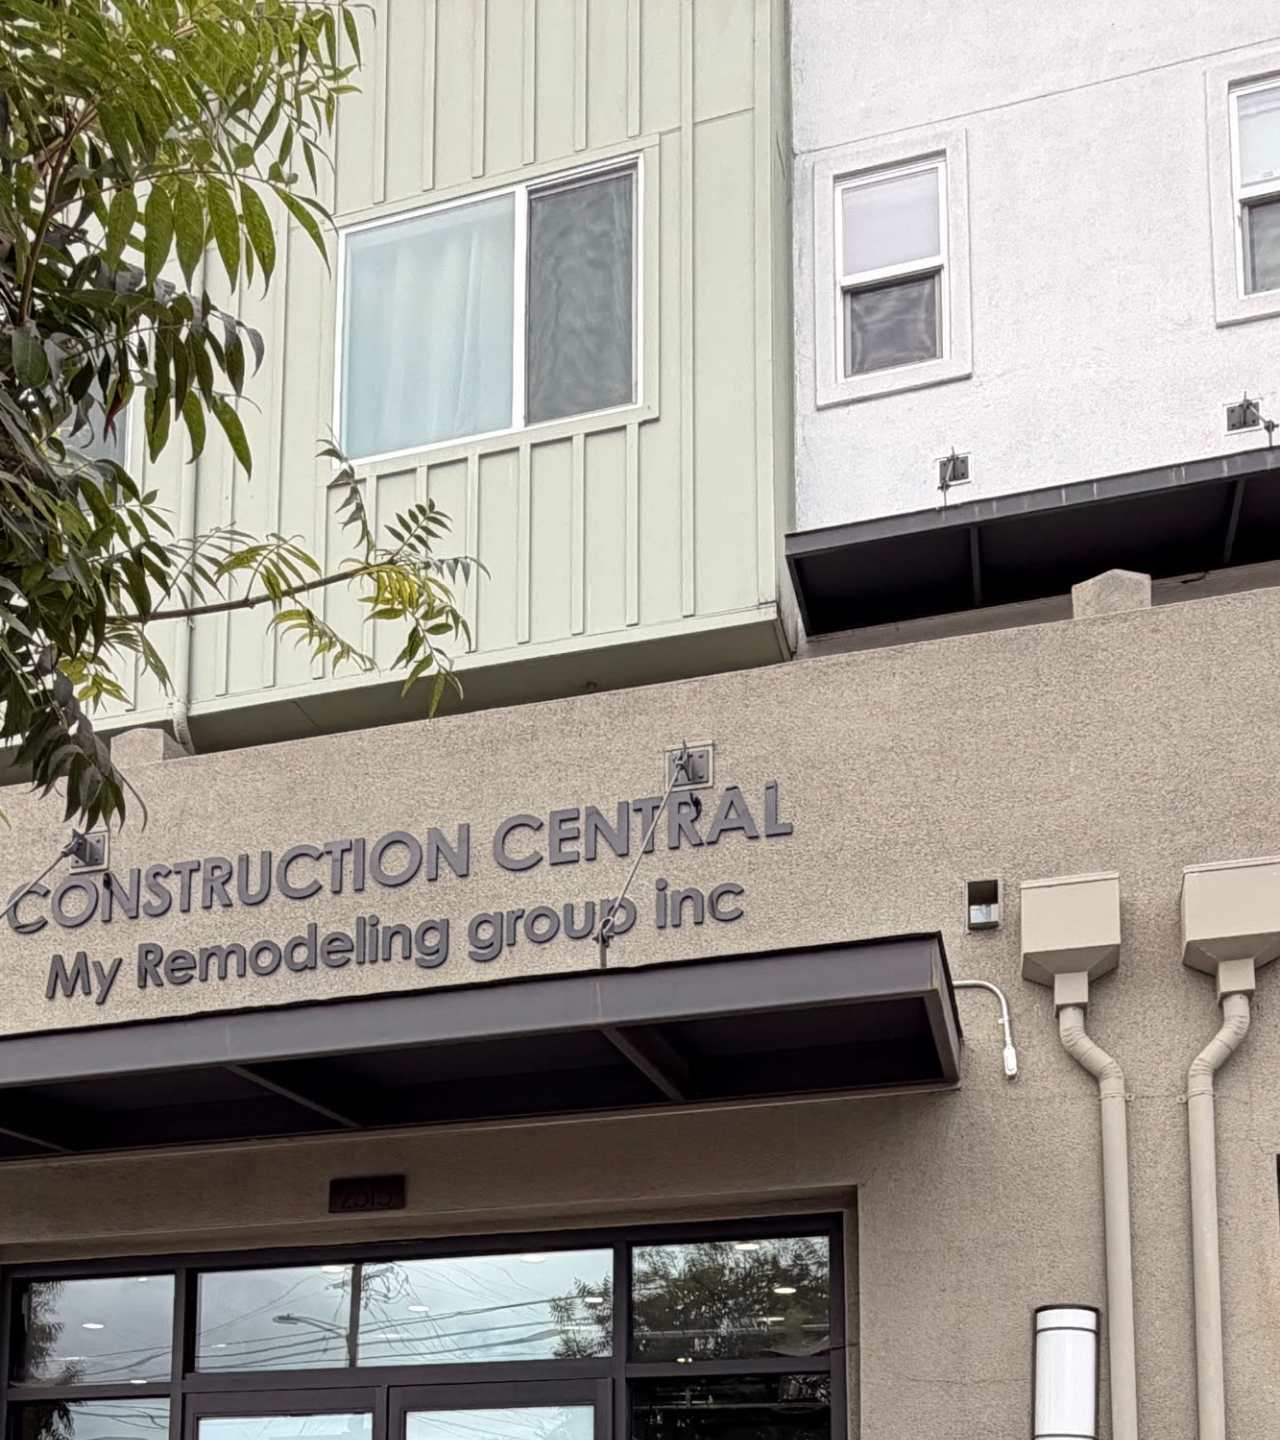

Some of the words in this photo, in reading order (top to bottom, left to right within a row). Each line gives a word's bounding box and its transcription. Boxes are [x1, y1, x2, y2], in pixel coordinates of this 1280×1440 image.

[6, 822, 470, 935] CONSTRUCTION
[492, 779, 794, 872] CENTRAL
[45, 950, 123, 1005] My
[137, 914, 450, 989] Remodeling
[468, 893, 638, 962] group
[655, 877, 746, 929] inc
